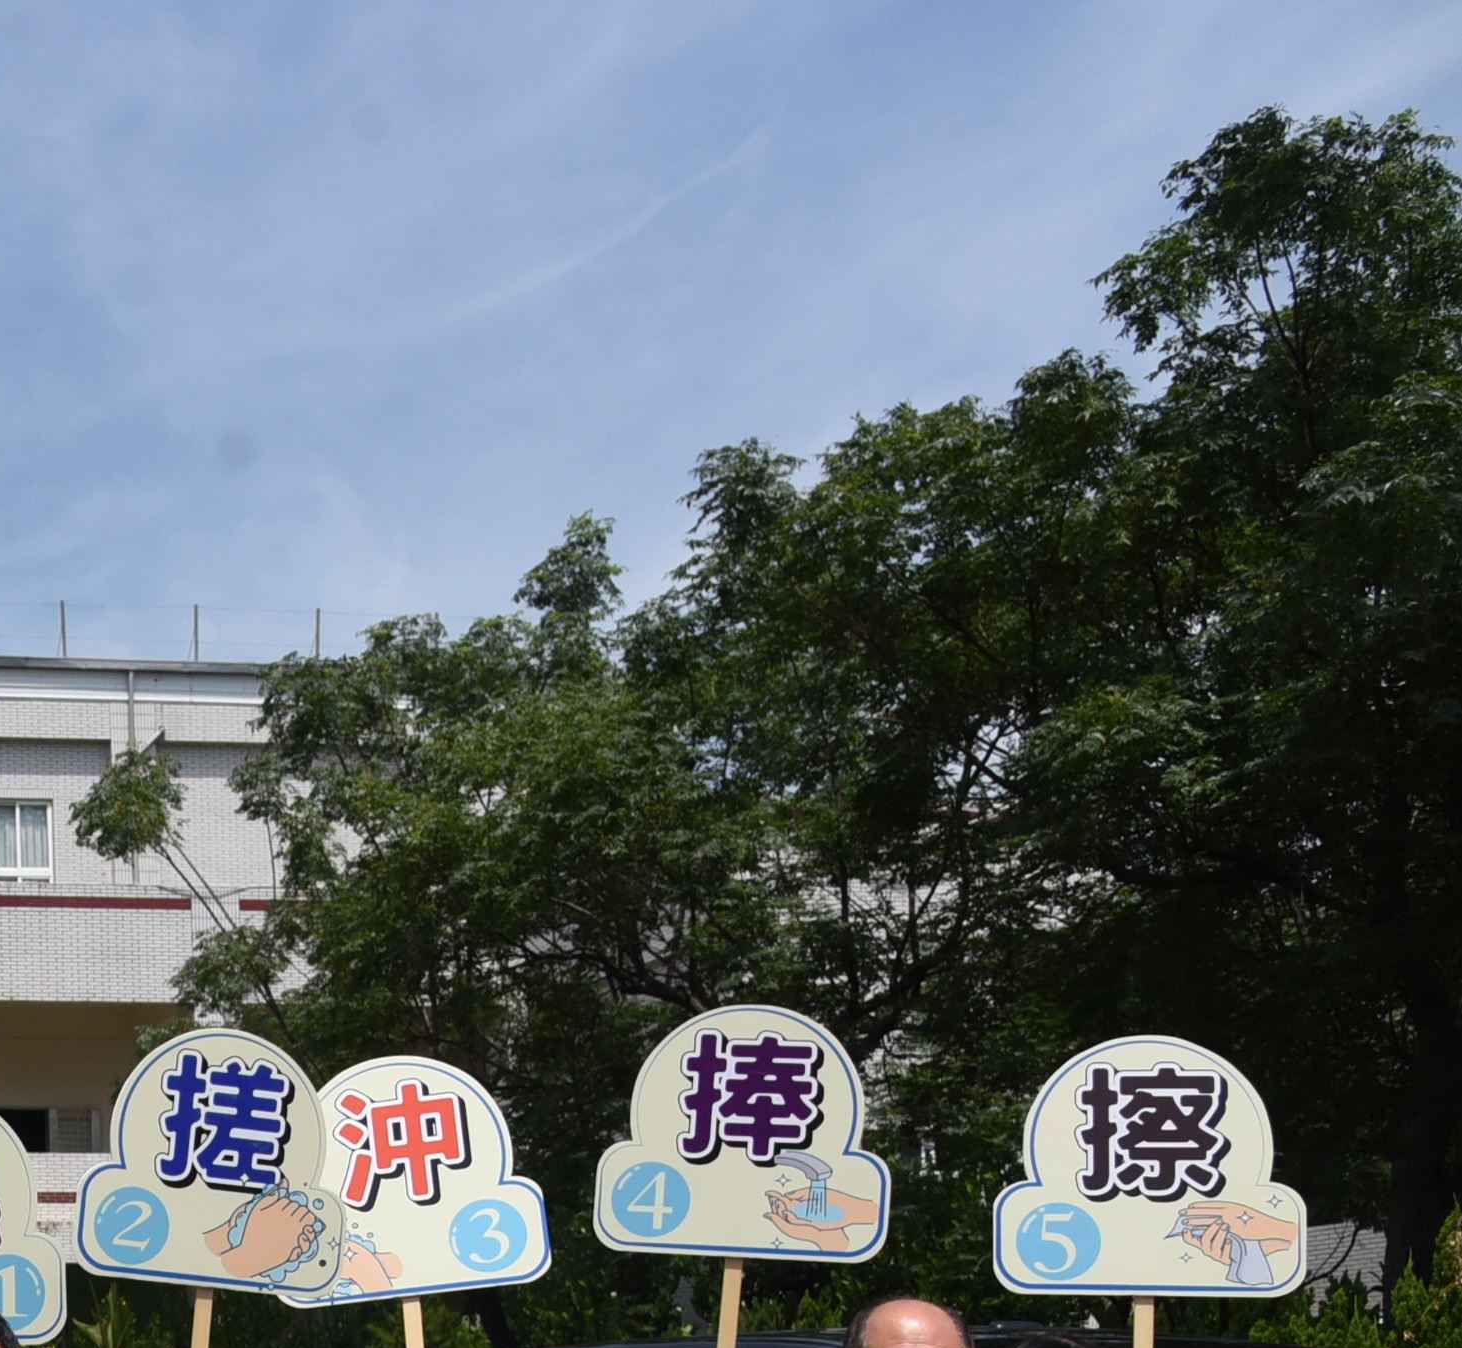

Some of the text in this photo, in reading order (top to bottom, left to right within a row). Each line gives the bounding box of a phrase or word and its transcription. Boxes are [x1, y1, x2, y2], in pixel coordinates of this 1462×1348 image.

[155, 1048, 292, 1194] 搓
[332, 1078, 470, 1211] 沖
[677, 1028, 823, 1163] 捧
[1075, 1061, 1229, 1200] 擦
[113, 1202, 156, 1249] 2
[471, 1208, 510, 1264] 3
[627, 1170, 674, 1231] 4
[1041, 1209, 1078, 1273] 5
